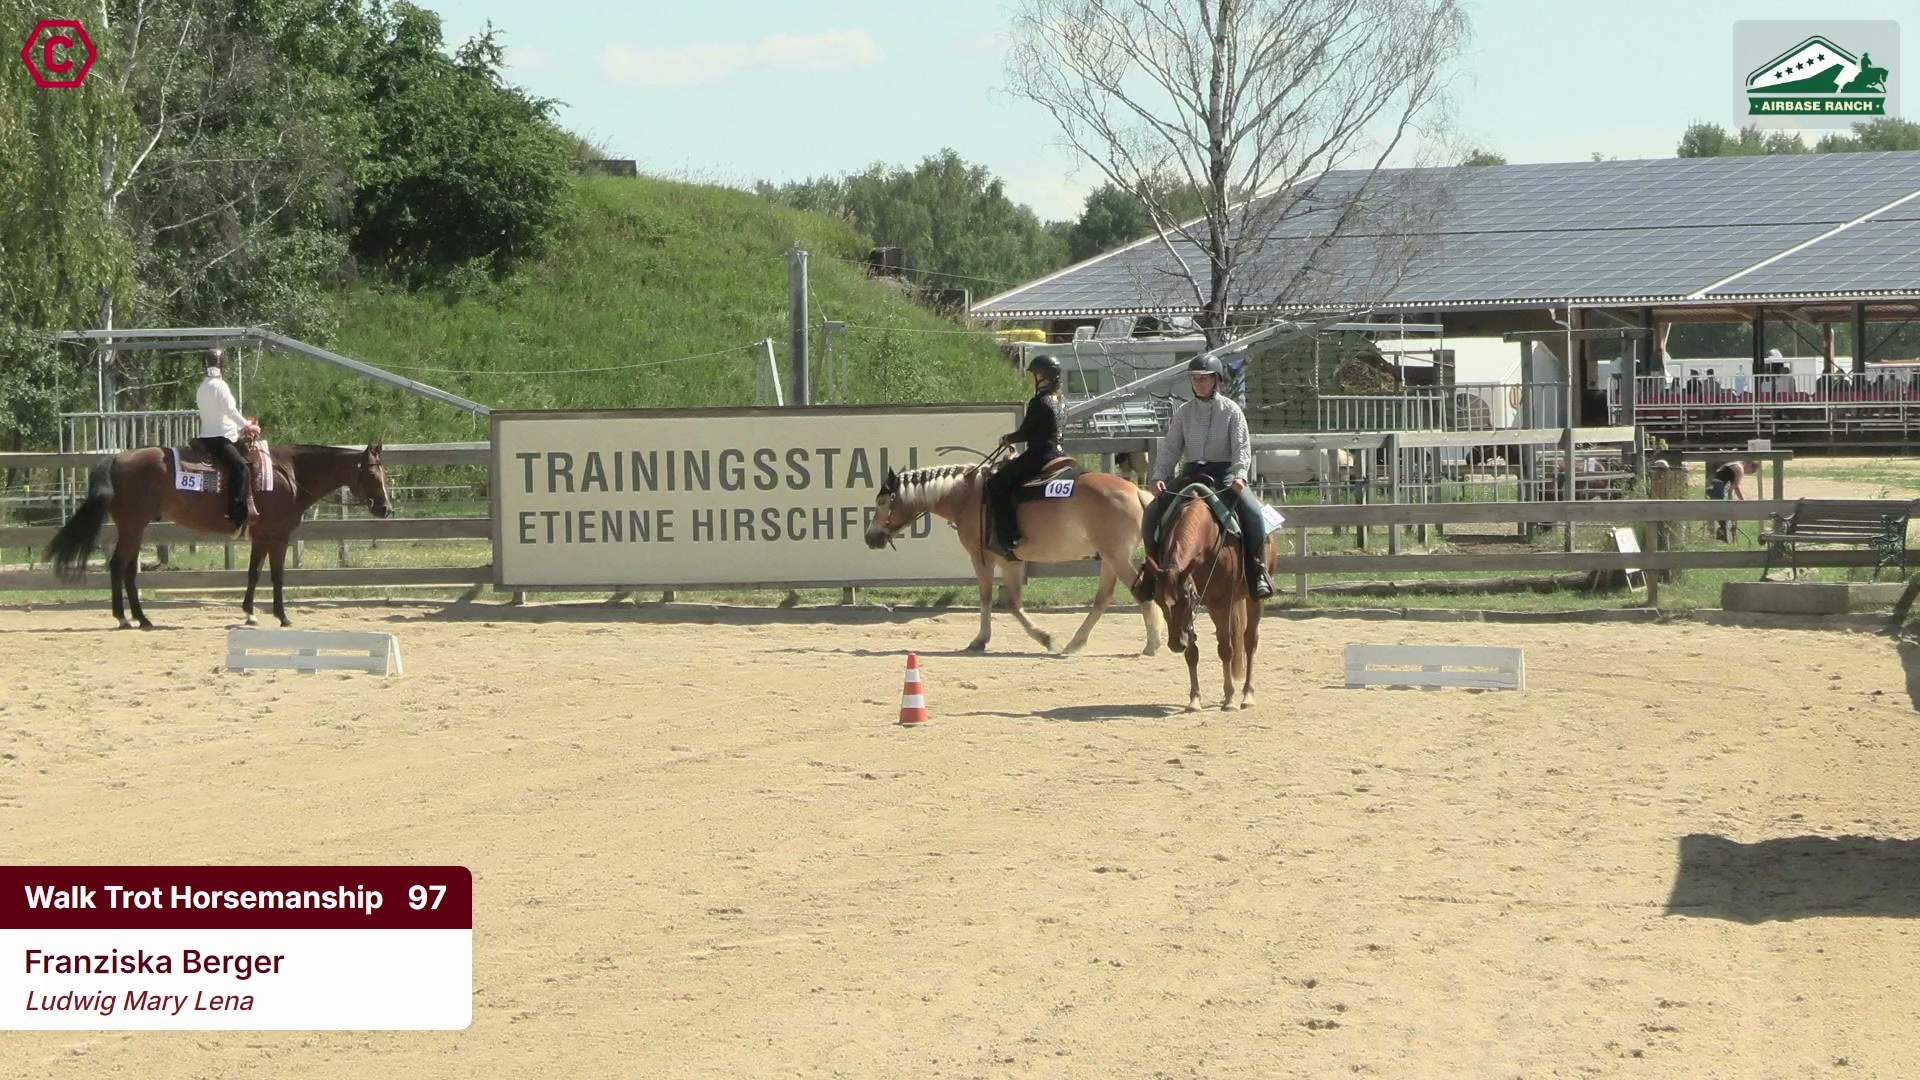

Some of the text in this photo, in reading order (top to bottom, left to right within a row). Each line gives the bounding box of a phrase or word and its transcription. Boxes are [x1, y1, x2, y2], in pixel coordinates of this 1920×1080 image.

[181, 475, 195, 487] 85
[1049, 483, 1070, 494] 105
[519, 507, 932, 544] ETIENNE HIRSCHFED
